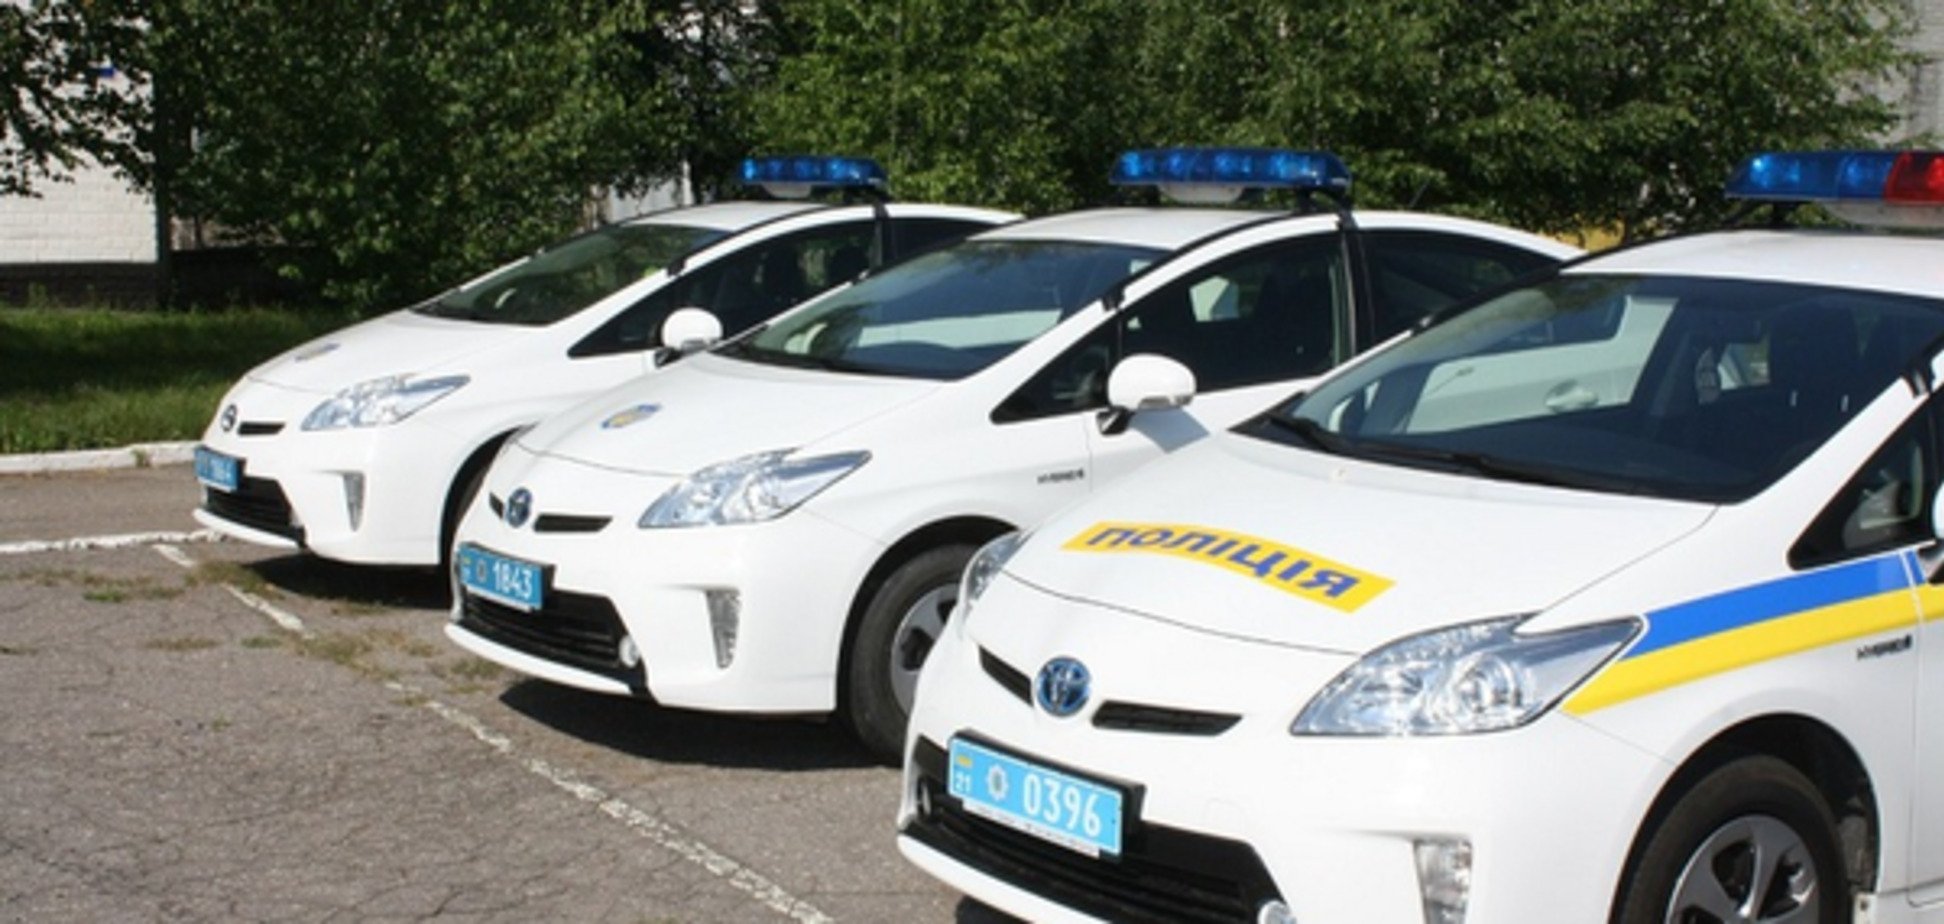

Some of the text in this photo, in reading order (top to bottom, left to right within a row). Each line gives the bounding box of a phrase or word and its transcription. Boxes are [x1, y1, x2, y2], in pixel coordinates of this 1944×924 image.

[492, 560, 532, 600] 1843
[1086, 527, 1360, 598] ПОЛІЦІЯ
[955, 771, 971, 793] 21
[1023, 773, 1102, 837] 0396
